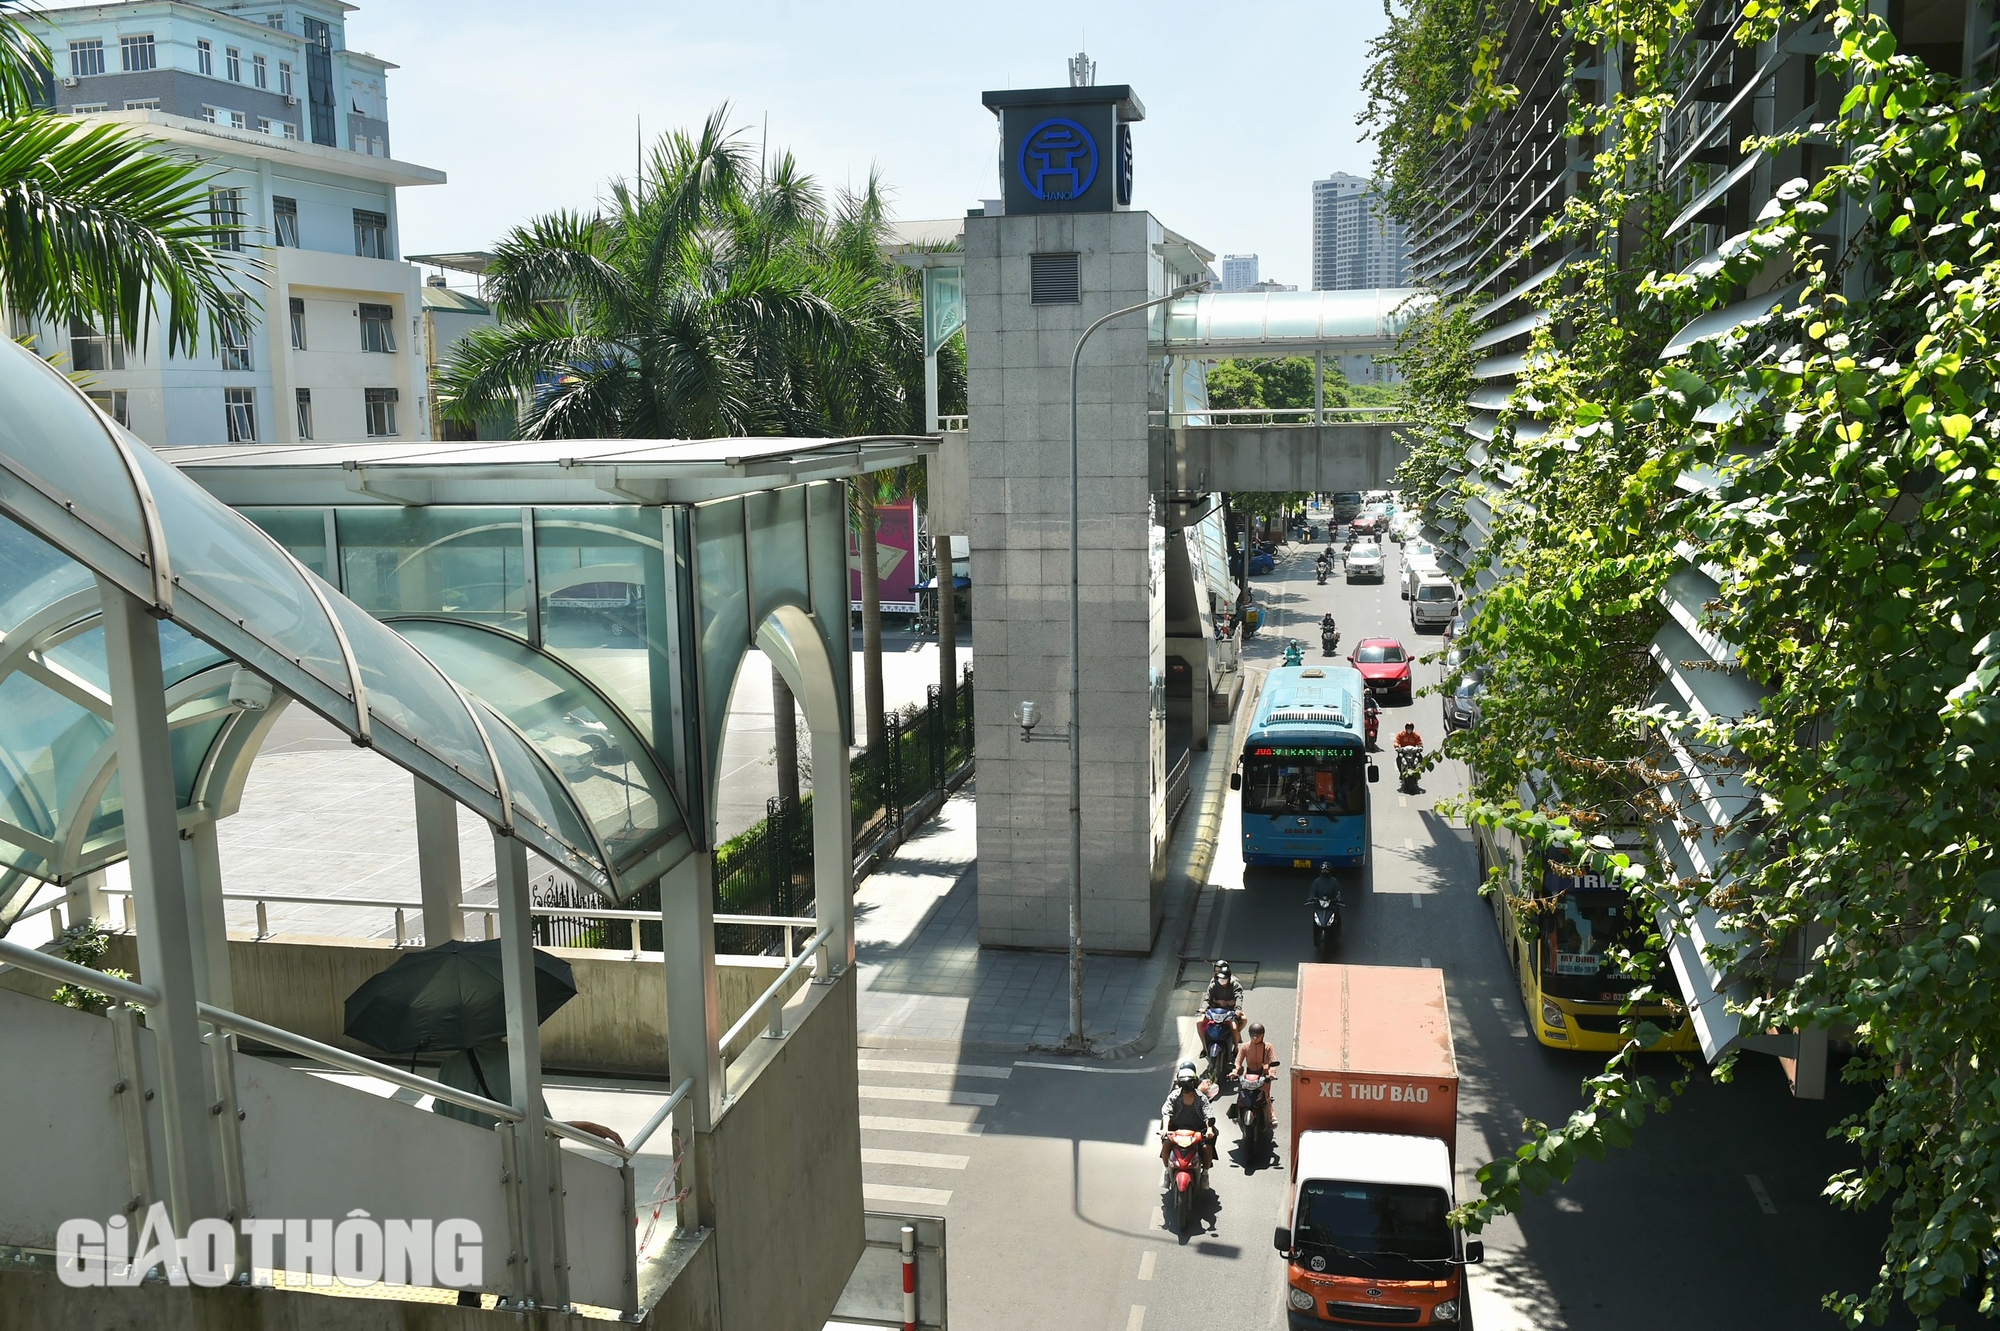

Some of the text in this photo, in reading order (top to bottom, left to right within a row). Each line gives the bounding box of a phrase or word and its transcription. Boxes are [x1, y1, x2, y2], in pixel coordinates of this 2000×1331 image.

[1043, 191, 1073, 201] HANOI
[1319, 1081, 1429, 1103] XE THƯ BÁO
[1312, 1258, 1326, 1268] 260
